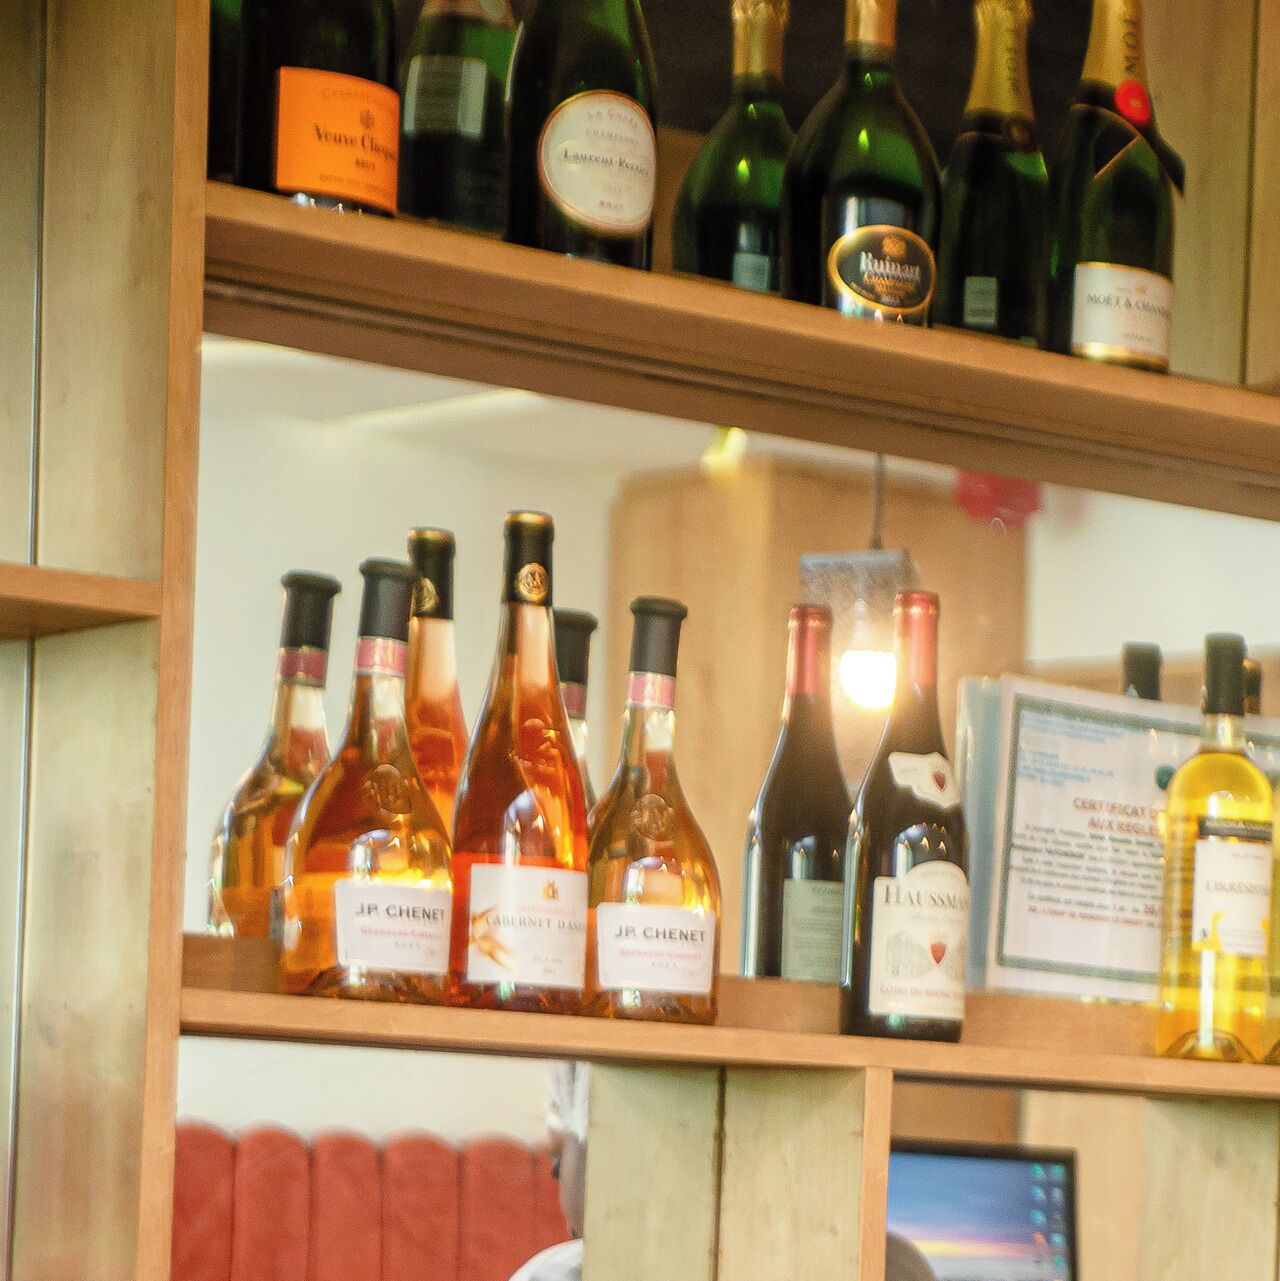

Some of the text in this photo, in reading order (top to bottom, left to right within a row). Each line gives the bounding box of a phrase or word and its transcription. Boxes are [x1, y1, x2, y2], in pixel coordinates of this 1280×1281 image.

[313, 121, 357, 147] Veuve
[386, 903, 446, 922] CHENET
[486, 914, 554, 929] CABERNET
[643, 926, 707, 943] CHENET
